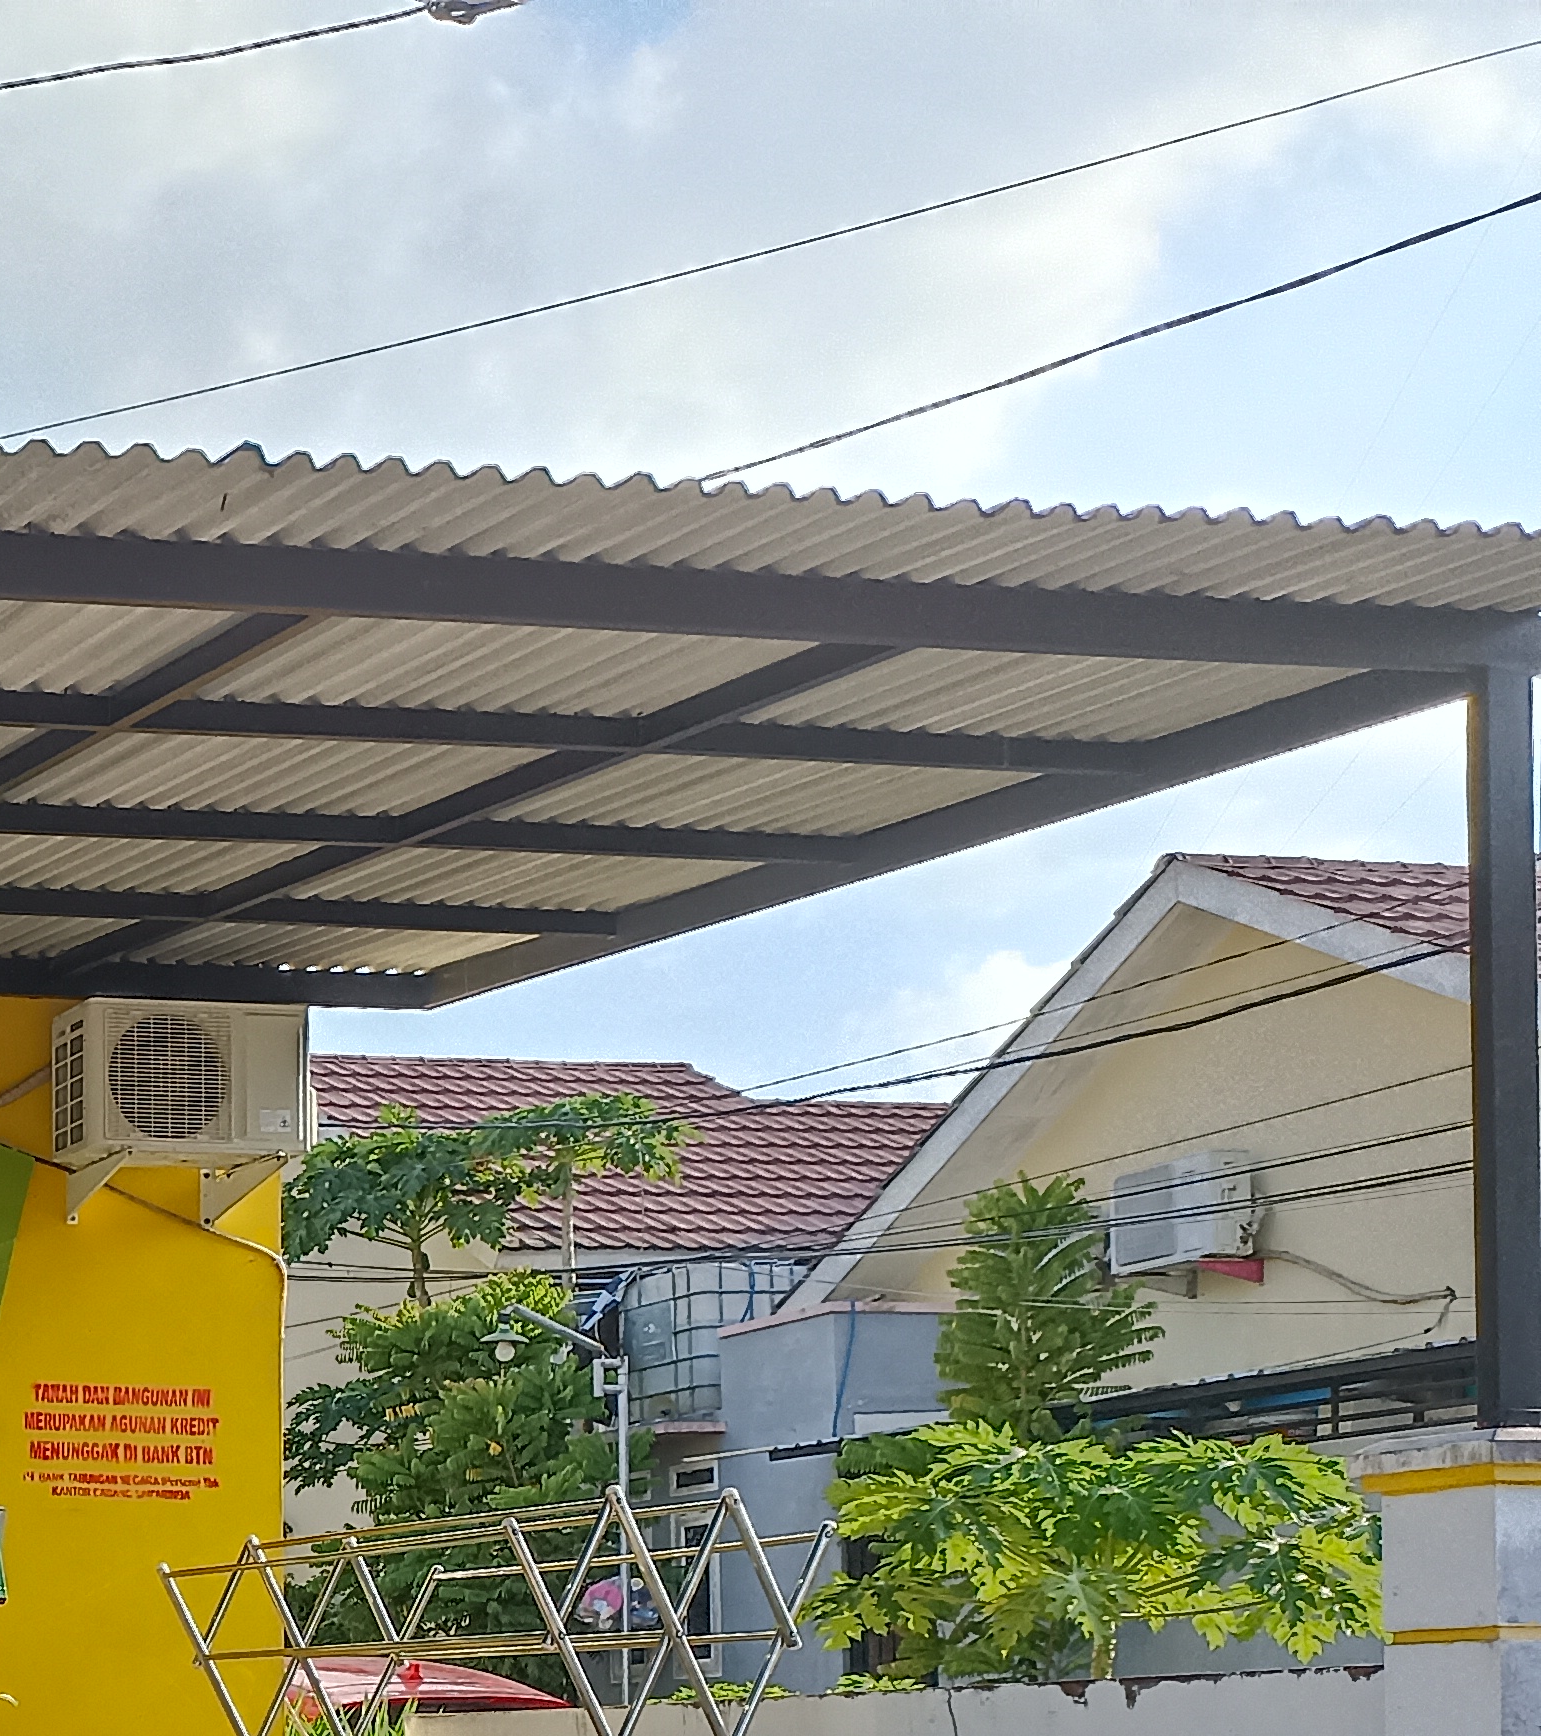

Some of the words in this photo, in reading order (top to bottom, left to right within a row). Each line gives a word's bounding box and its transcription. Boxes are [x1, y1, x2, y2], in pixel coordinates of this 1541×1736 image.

[33, 1383, 78, 1404] TANAH
[82, 1385, 110, 1404] DAN
[113, 1386, 188, 1407] BANGUNAN
[191, 1388, 211, 1408] INI
[24, 1412, 106, 1432] MERUPAKAN
[110, 1415, 166, 1434] AGUNAN
[170, 1417, 219, 1436] KREDIT
[29, 1440, 119, 1463] MENUNGGAK
[123, 1444, 137, 1463] DI
[142, 1445, 181, 1464] BANK
[185, 1446, 214, 1465] BTN
[52, 1486, 90, 1496] KANTOR
